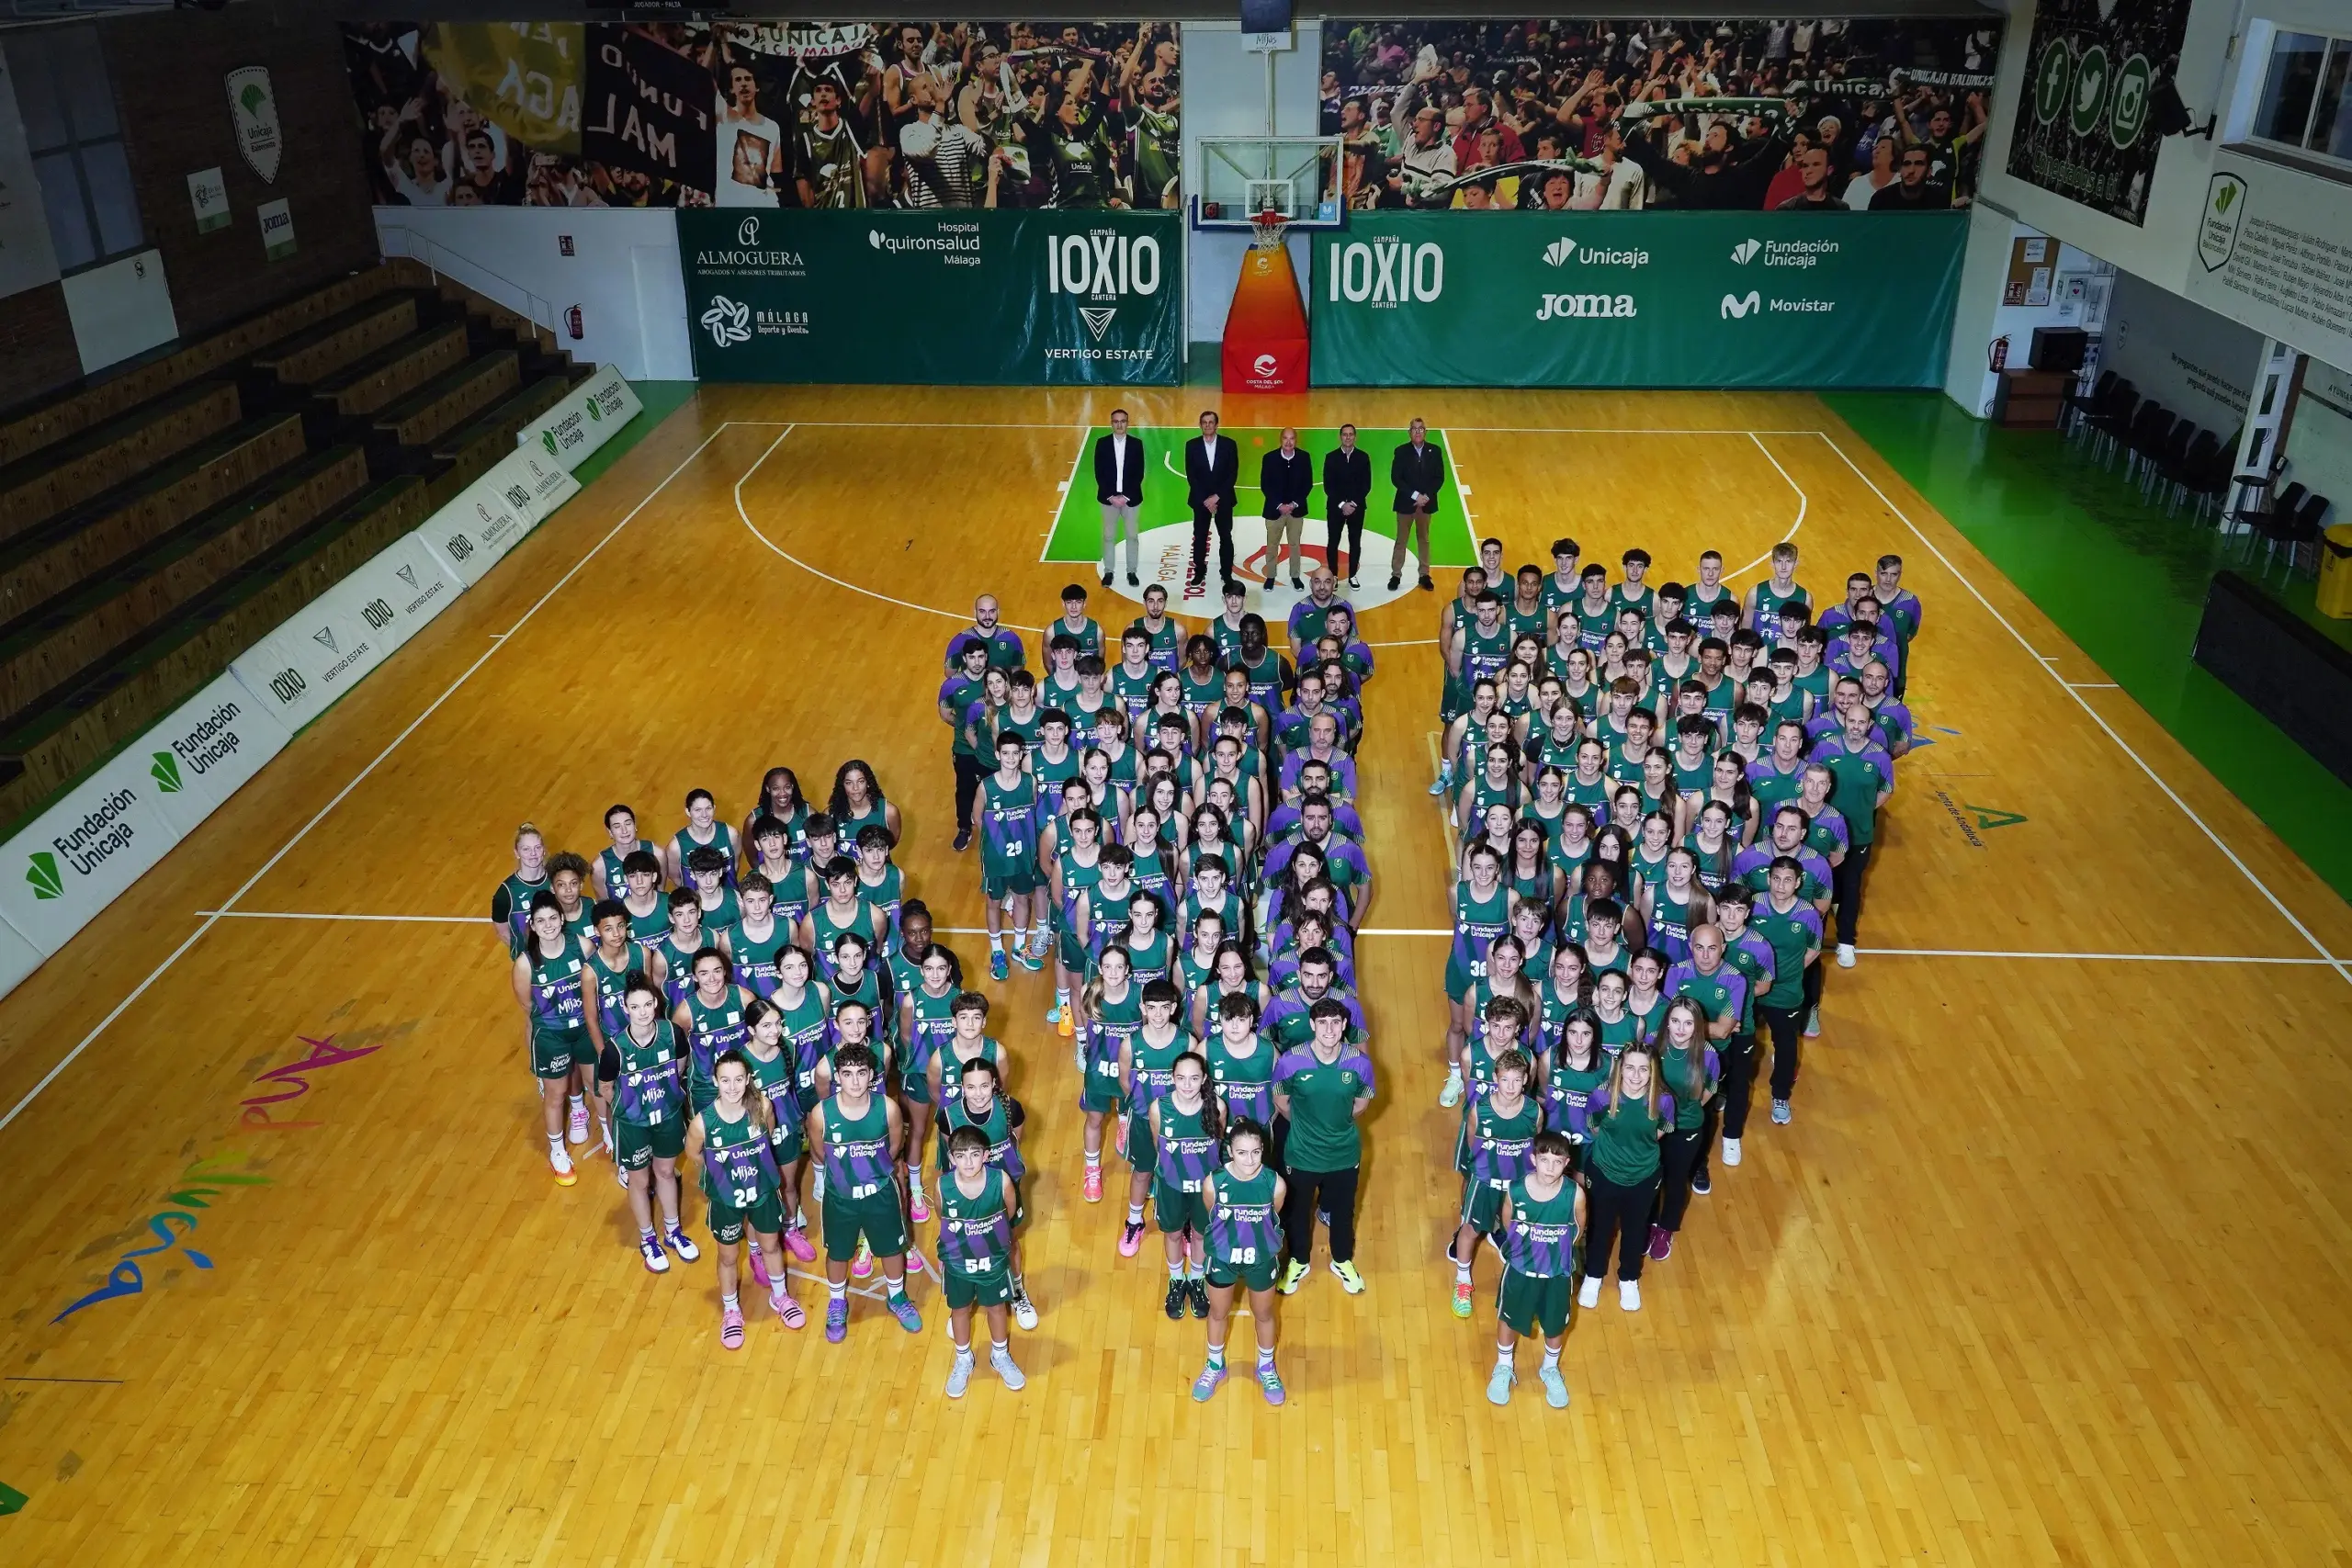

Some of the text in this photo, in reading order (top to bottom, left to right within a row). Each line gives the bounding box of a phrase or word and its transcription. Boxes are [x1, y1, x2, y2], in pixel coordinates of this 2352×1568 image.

[247, 125, 273, 141] Unicaja
[938, 222, 979, 233] Hospital
[2207, 218, 2232, 234] Fundación
[886, 236, 979, 254] quirónsalud
[2208, 230, 2226, 245] Unicaja
[1765, 239, 1839, 254] Fundación
[696, 251, 804, 265] ALMOGUERA
[944, 254, 980, 266] Málaga
[1579, 247, 1649, 269] Unicaja
[1764, 254, 1816, 269] Unicaja
[1770, 299, 1835, 312] Movistar
[757, 309, 808, 322] MÁLAGA
[1045, 349, 1153, 359] VERTIGO ESTATE
[594, 381, 622, 403] Fundación
[601, 397, 623, 416] Unicaja
[551, 411, 582, 436] Fundación
[559, 428, 583, 449] Unicaja
[1157, 545, 1184, 581] MÁLAGA
[405, 581, 445, 615] VERTIGO ESTATE
[322, 642, 369, 682] VERTIGO ESTATE
[171, 702, 242, 760] Fundación
[187, 731, 241, 774] Unicaja
[1006, 807, 1031, 816] Fundación
[1006, 813, 1026, 822] Unicaja
[1935, 790, 1985, 847] Junta de Andalucía
[52, 788, 138, 859] Fundación
[70, 822, 134, 875] Unicaja
[1005, 840, 1023, 856] 29
[1471, 925, 1504, 933] Fundación
[1471, 930, 1496, 939] Unicaja
[715, 1028, 745, 1044] Unicaja
[798, 1032, 823, 1045] Unicaja
[643, 1067, 675, 1085] Unicaja
[1099, 1061, 1119, 1077] 46
[642, 1088, 665, 1105] Mijas
[1229, 1085, 1264, 1093] Fundación
[1229, 1091, 1255, 1100] Unicaja
[649, 1109, 662, 1125] 11
[731, 1142, 766, 1159] Unicaja
[849, 1140, 886, 1153] Fundación
[1181, 1139, 1215, 1147] Fundación
[1181, 1145, 1207, 1155] Unicaja
[1496, 1142, 1531, 1150] Fundación
[849, 1147, 877, 1158] Unicaja
[1496, 1147, 1521, 1156] Unicaja
[731, 1165, 759, 1182] Mijas
[1234, 1207, 1270, 1217] Fundación
[1234, 1214, 1262, 1224] Unicaja
[964, 1214, 1002, 1232] Fundación
[965, 1224, 993, 1236] Unicaja
[1530, 1226, 1567, 1235] Fundación
[1530, 1233, 1558, 1244] Unicaja
[1230, 1247, 1256, 1264] 48
[965, 1257, 991, 1273] 54
